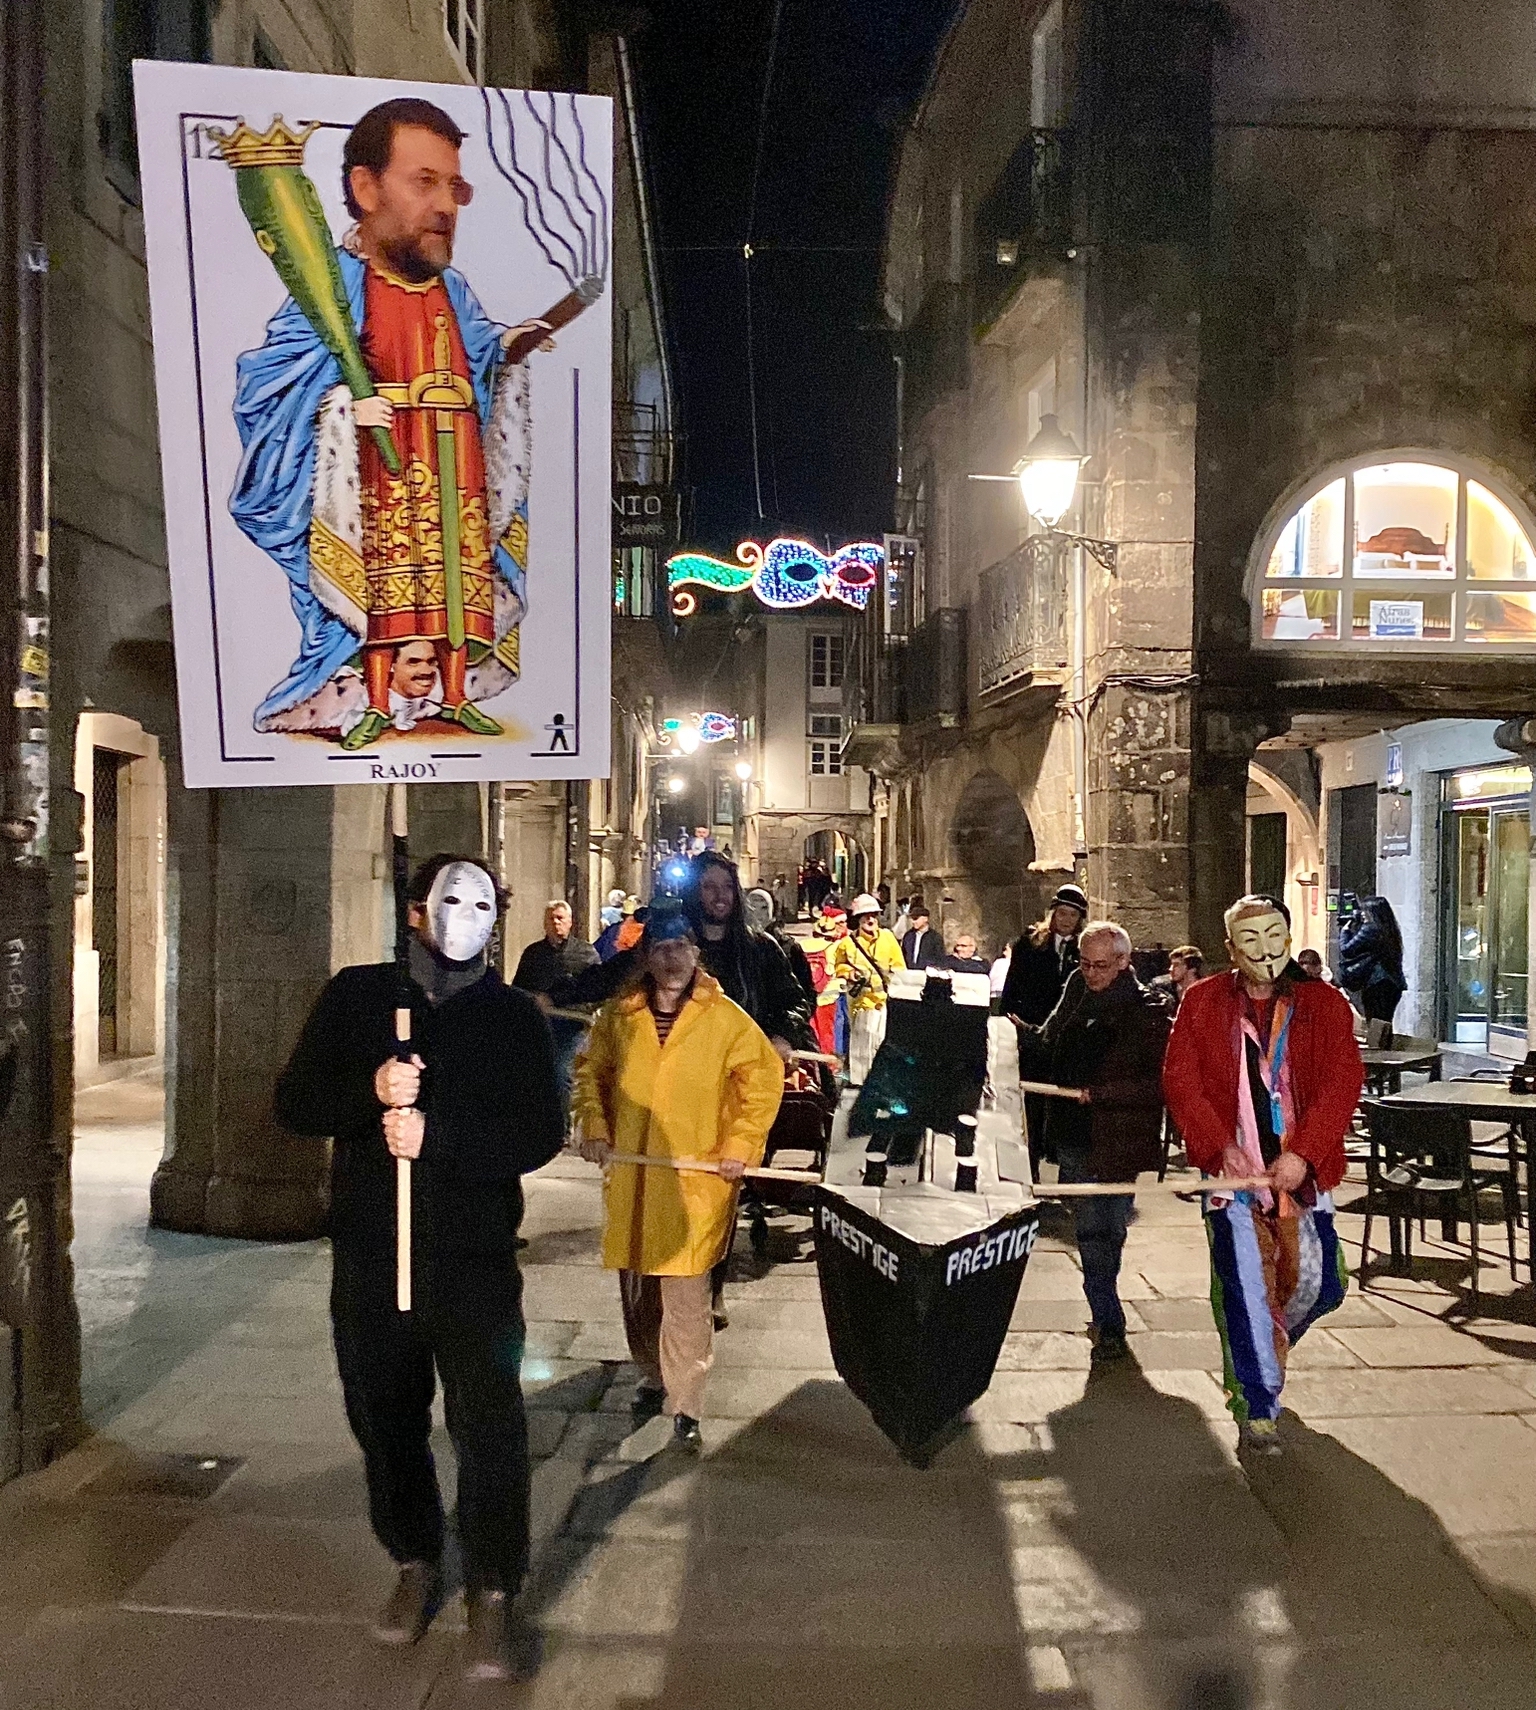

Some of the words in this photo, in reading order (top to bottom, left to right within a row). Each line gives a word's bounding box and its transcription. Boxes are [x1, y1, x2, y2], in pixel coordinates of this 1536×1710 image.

[370, 763, 441, 778] RAJOY
[821, 1205, 899, 1283] PRESTIGE
[946, 1219, 1040, 1287] PRESTIGE
